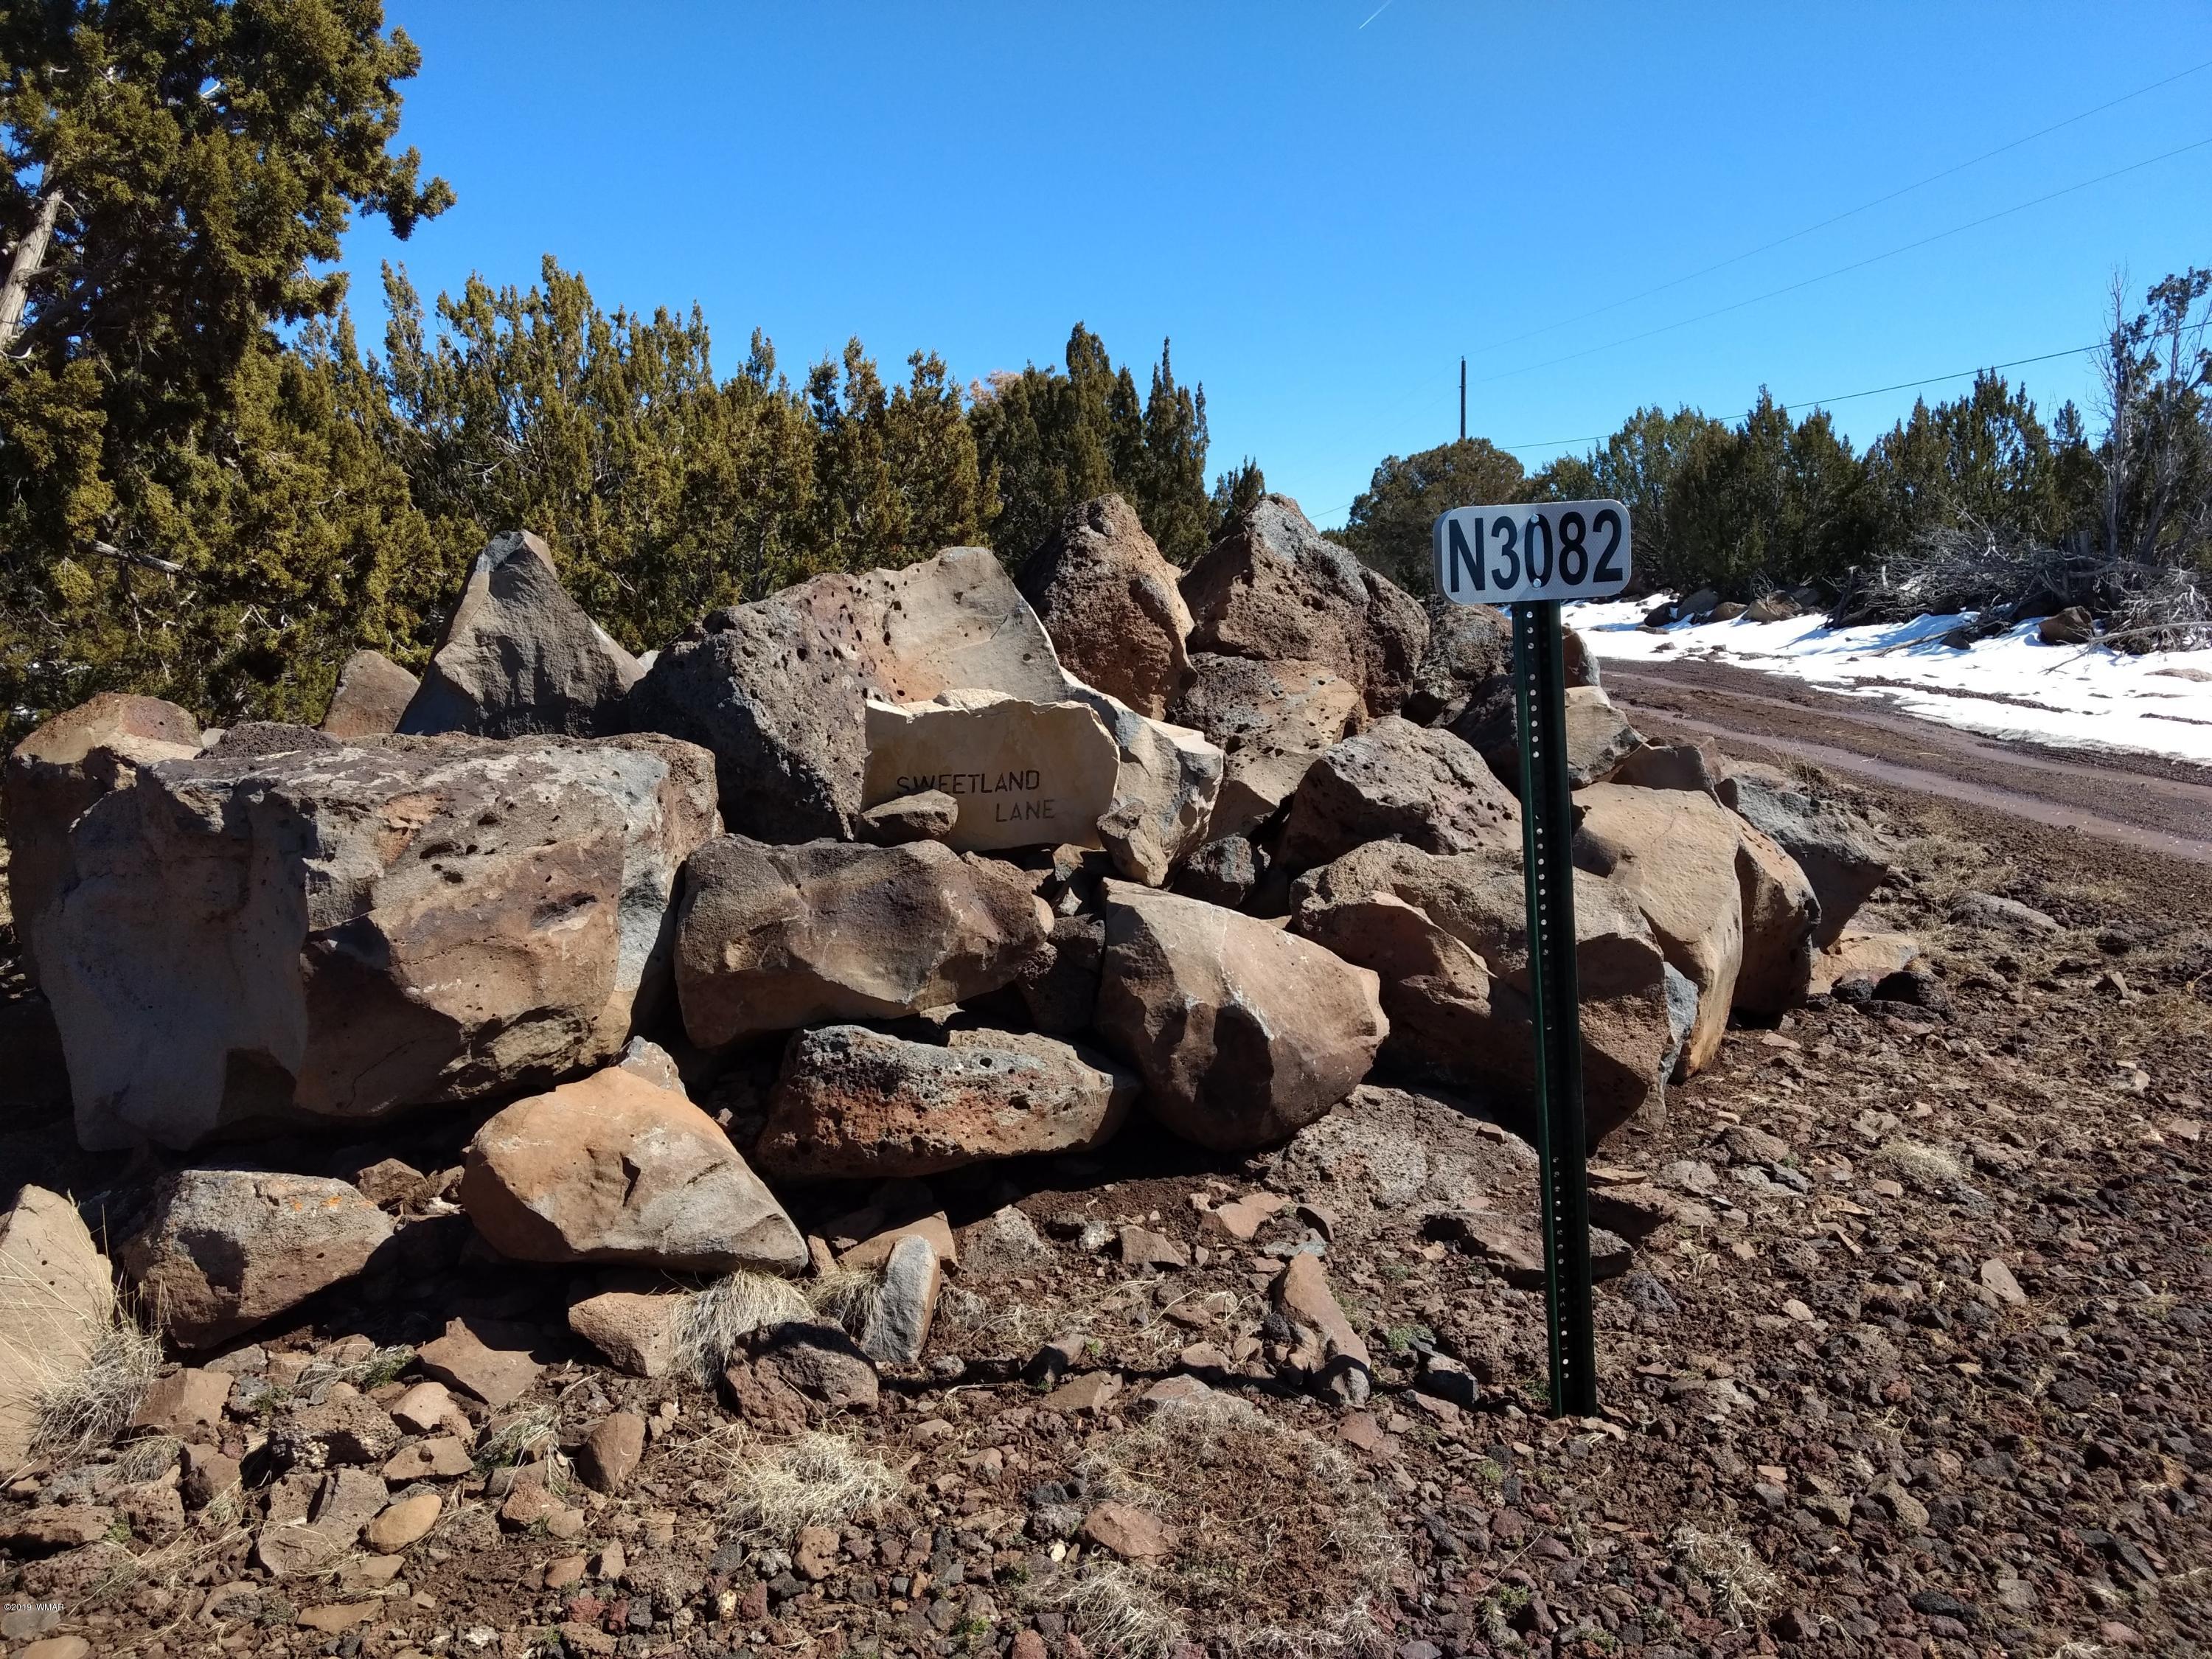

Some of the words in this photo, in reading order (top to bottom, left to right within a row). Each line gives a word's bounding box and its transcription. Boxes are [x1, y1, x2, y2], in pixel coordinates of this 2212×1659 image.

[1448, 509, 1623, 593] N3082
[896, 770, 1040, 795] SWEETLAND
[995, 799, 1055, 822] LANE
